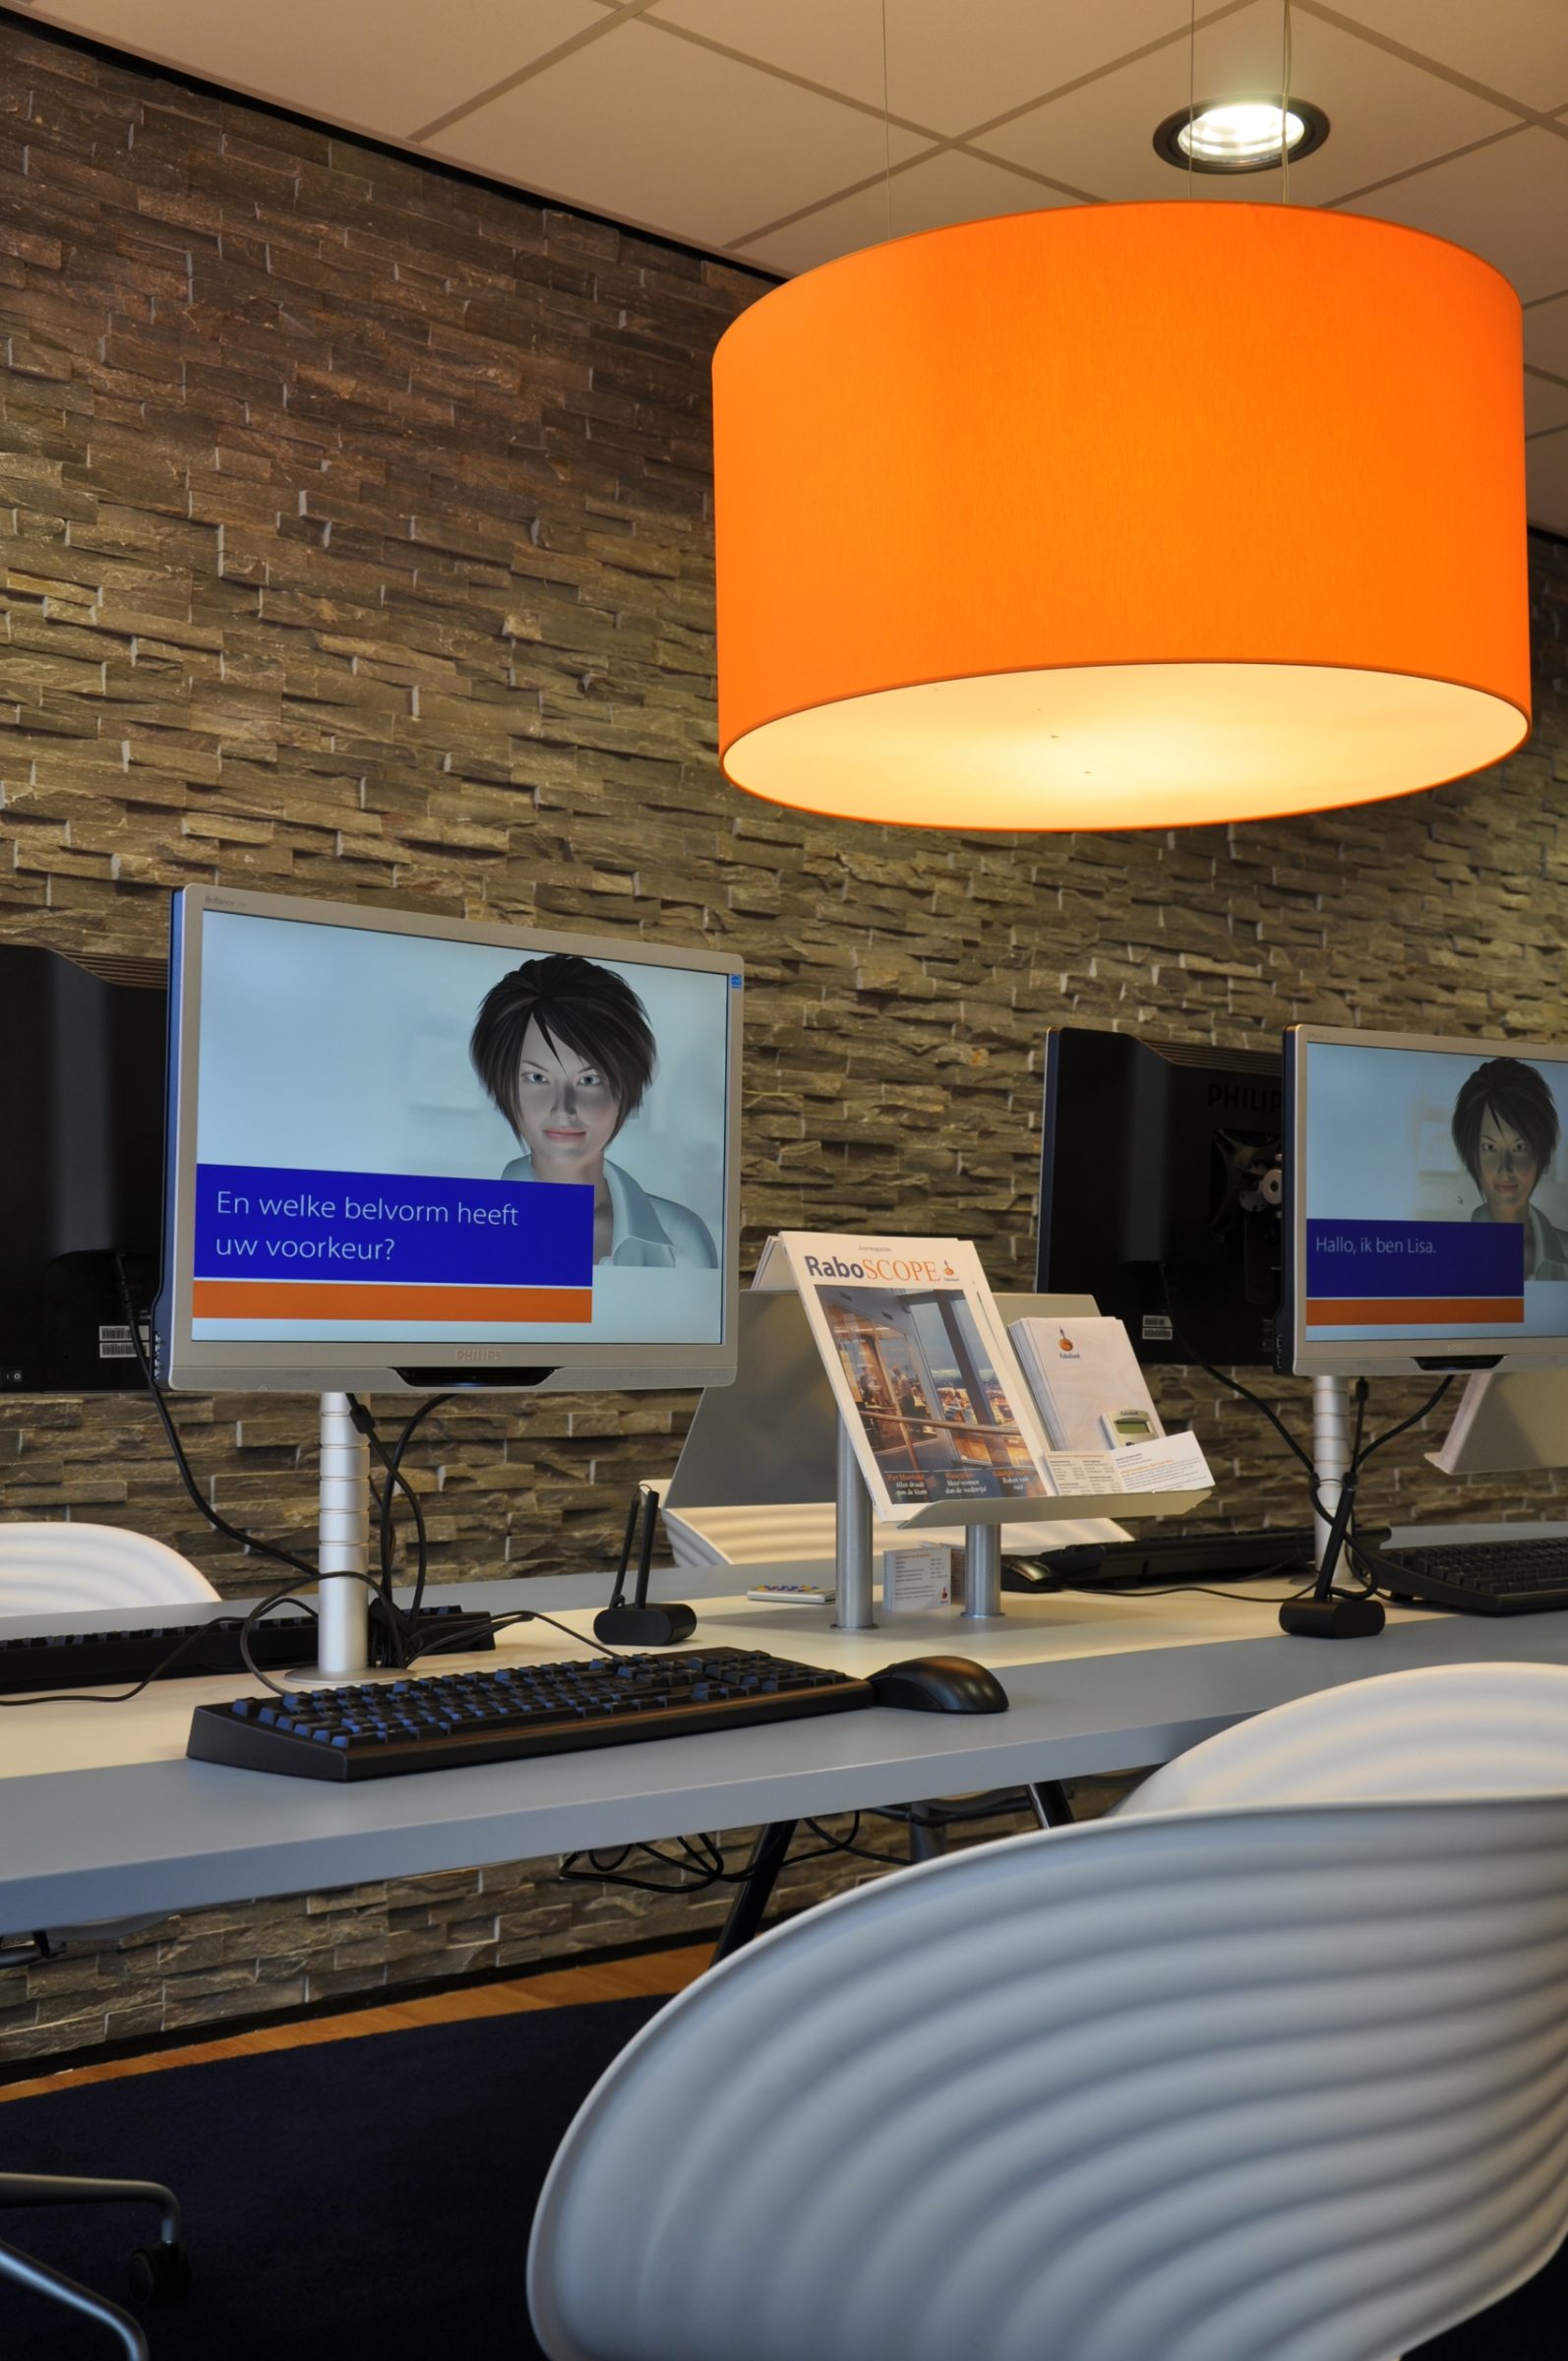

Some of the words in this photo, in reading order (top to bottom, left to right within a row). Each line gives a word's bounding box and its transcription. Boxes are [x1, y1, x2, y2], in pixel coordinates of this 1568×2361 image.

[1208, 1082, 1282, 1114] PHILIP
[216, 1190, 249, 1215] En
[259, 1193, 336, 1219] welke
[345, 1196, 450, 1223] belvorm
[458, 1202, 518, 1226] heeft
[215, 1238, 259, 1256] uw
[266, 1236, 395, 1261] voorkeur?
[1316, 1236, 1357, 1255] Hallo,
[1360, 1237, 1373, 1253] ik
[1376, 1237, 1404, 1254] ben
[1408, 1238, 1437, 1254] Lisa.
